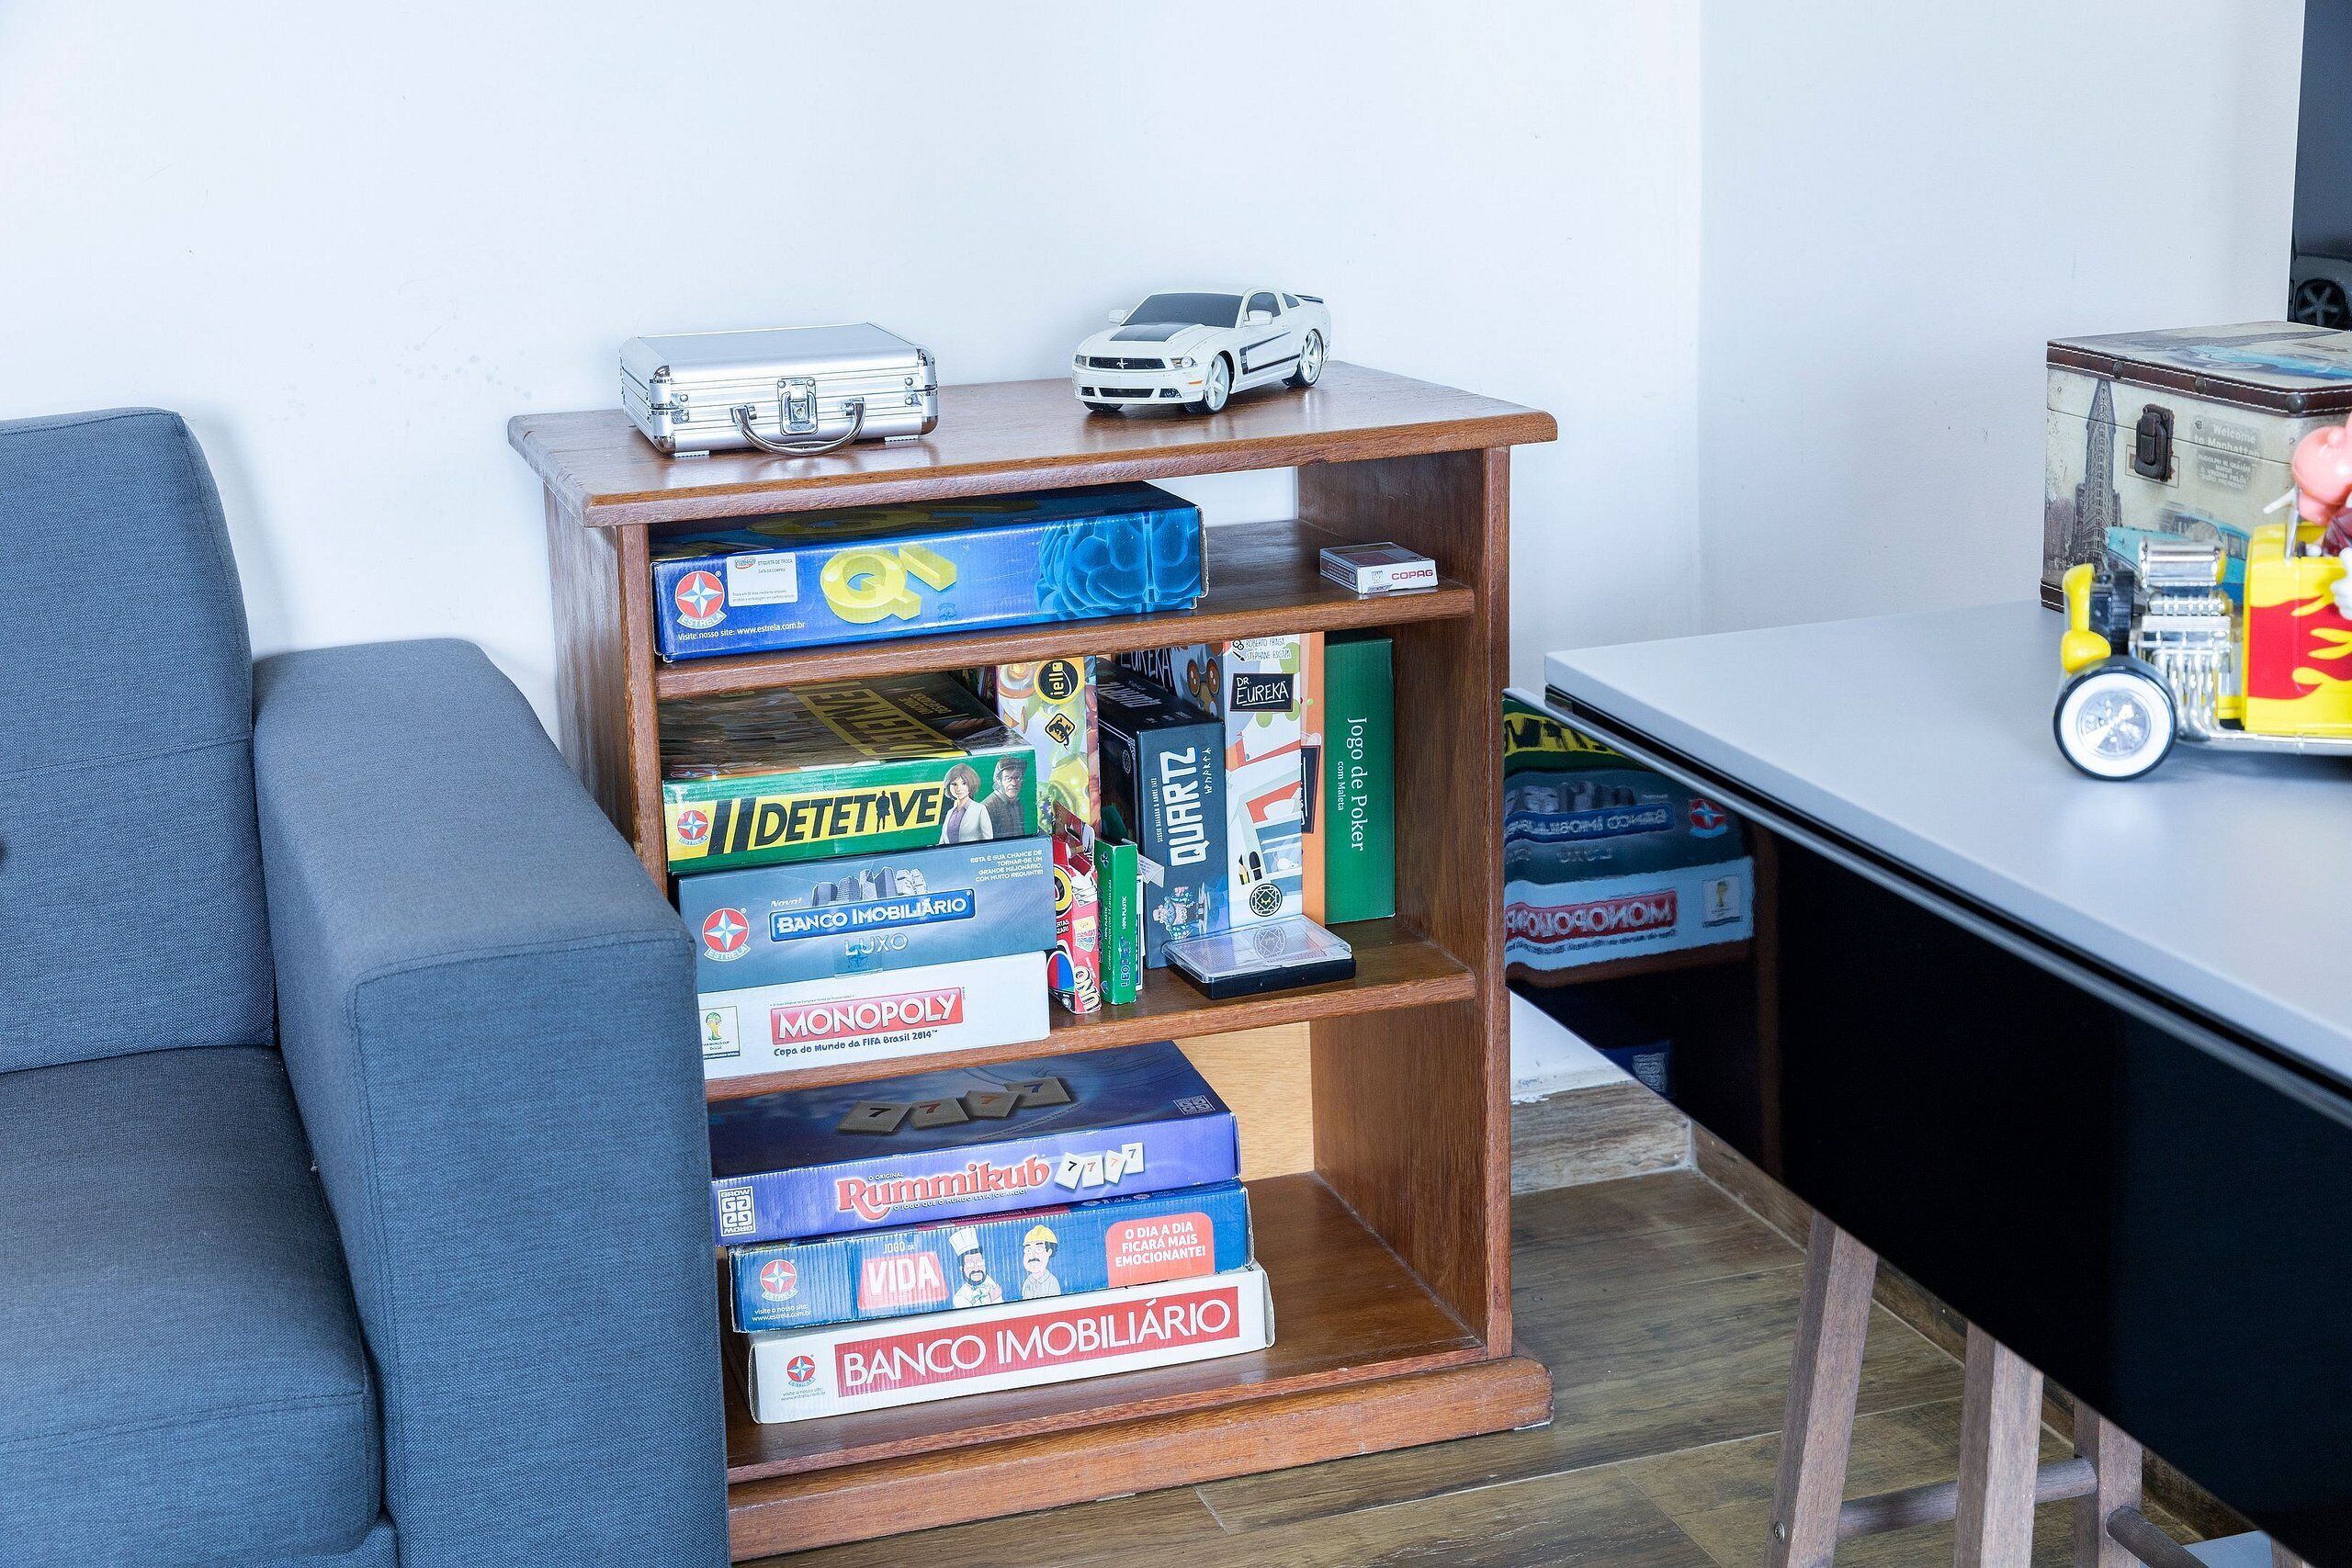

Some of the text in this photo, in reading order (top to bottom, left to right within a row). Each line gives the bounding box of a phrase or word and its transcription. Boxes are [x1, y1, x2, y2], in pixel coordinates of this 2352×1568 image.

[2194, 433, 2204, 445] to
[2213, 423, 2256, 444] Welcome
[1391, 570, 1433, 581] COPAG
[681, 612, 724, 627] ESTRELA
[678, 620, 806, 641] Visite nosso site: www.estrela.com.br
[1048, 661, 1065, 695] iello
[1237, 676, 1252, 687] DR.
[1236, 680, 1289, 705] EUREKA
[1346, 717, 1368, 852] Jogo de Poker
[1159, 747, 1210, 866] QUARTZ
[1337, 782, 1346, 811] Maleta
[997, 858, 1033, 867] TORNAR-SE
[1007, 850, 1033, 859] CHANCE
[975, 869, 1044, 883] COM MUITO REQUINTE!
[978, 867, 1005, 875] GRANDE
[777, 897, 967, 935] BANCO IMOBILIÁRIO
[707, 943, 749, 961] ESTRELA
[843, 931, 909, 957] LUXO
[1075, 965, 1101, 1012] UNO
[779, 993, 957, 1039] MONOPOLY
[774, 1045, 797, 1057] Copa
[800, 1043, 812, 1054] do
[814, 1041, 846, 1053] Mundo
[848, 1039, 861, 1048] da
[863, 1036, 881, 1046] FIFA
[883, 1032, 910, 1043] Brasil
[869, 1082, 1044, 1118] 7 7 7 7
[1068, 1148, 1137, 1172] 7 7 7 7
[875, 1172, 904, 1180] ORIGINAL
[720, 1188, 751, 1198] GROW
[837, 1156, 1050, 1220] Rummikub
[900, 1201, 921, 1212] JOGO
[922, 1200, 937, 1209] QUE
[946, 1195, 972, 1204] MUNDO
[991, 1189, 1028, 1200] JOGANDO!
[1125, 1221, 1194, 1240] O DIA A DIA
[882, 1240, 905, 1255] JOGO
[1121, 1233, 1199, 1254] FICARÁ MAIS
[1115, 1244, 1207, 1268] EMOCIONANTE!
[867, 1257, 941, 1295] VIDA
[765, 1289, 797, 1301] ESTRELA
[752, 1309, 812, 1322] www.estrela.com.br
[754, 1305, 772, 1315] visite
[777, 1304, 796, 1313] nosso
[796, 1302, 809, 1312] site:
[843, 1298, 1232, 1388] BANCO IMOBILIÁRIO
